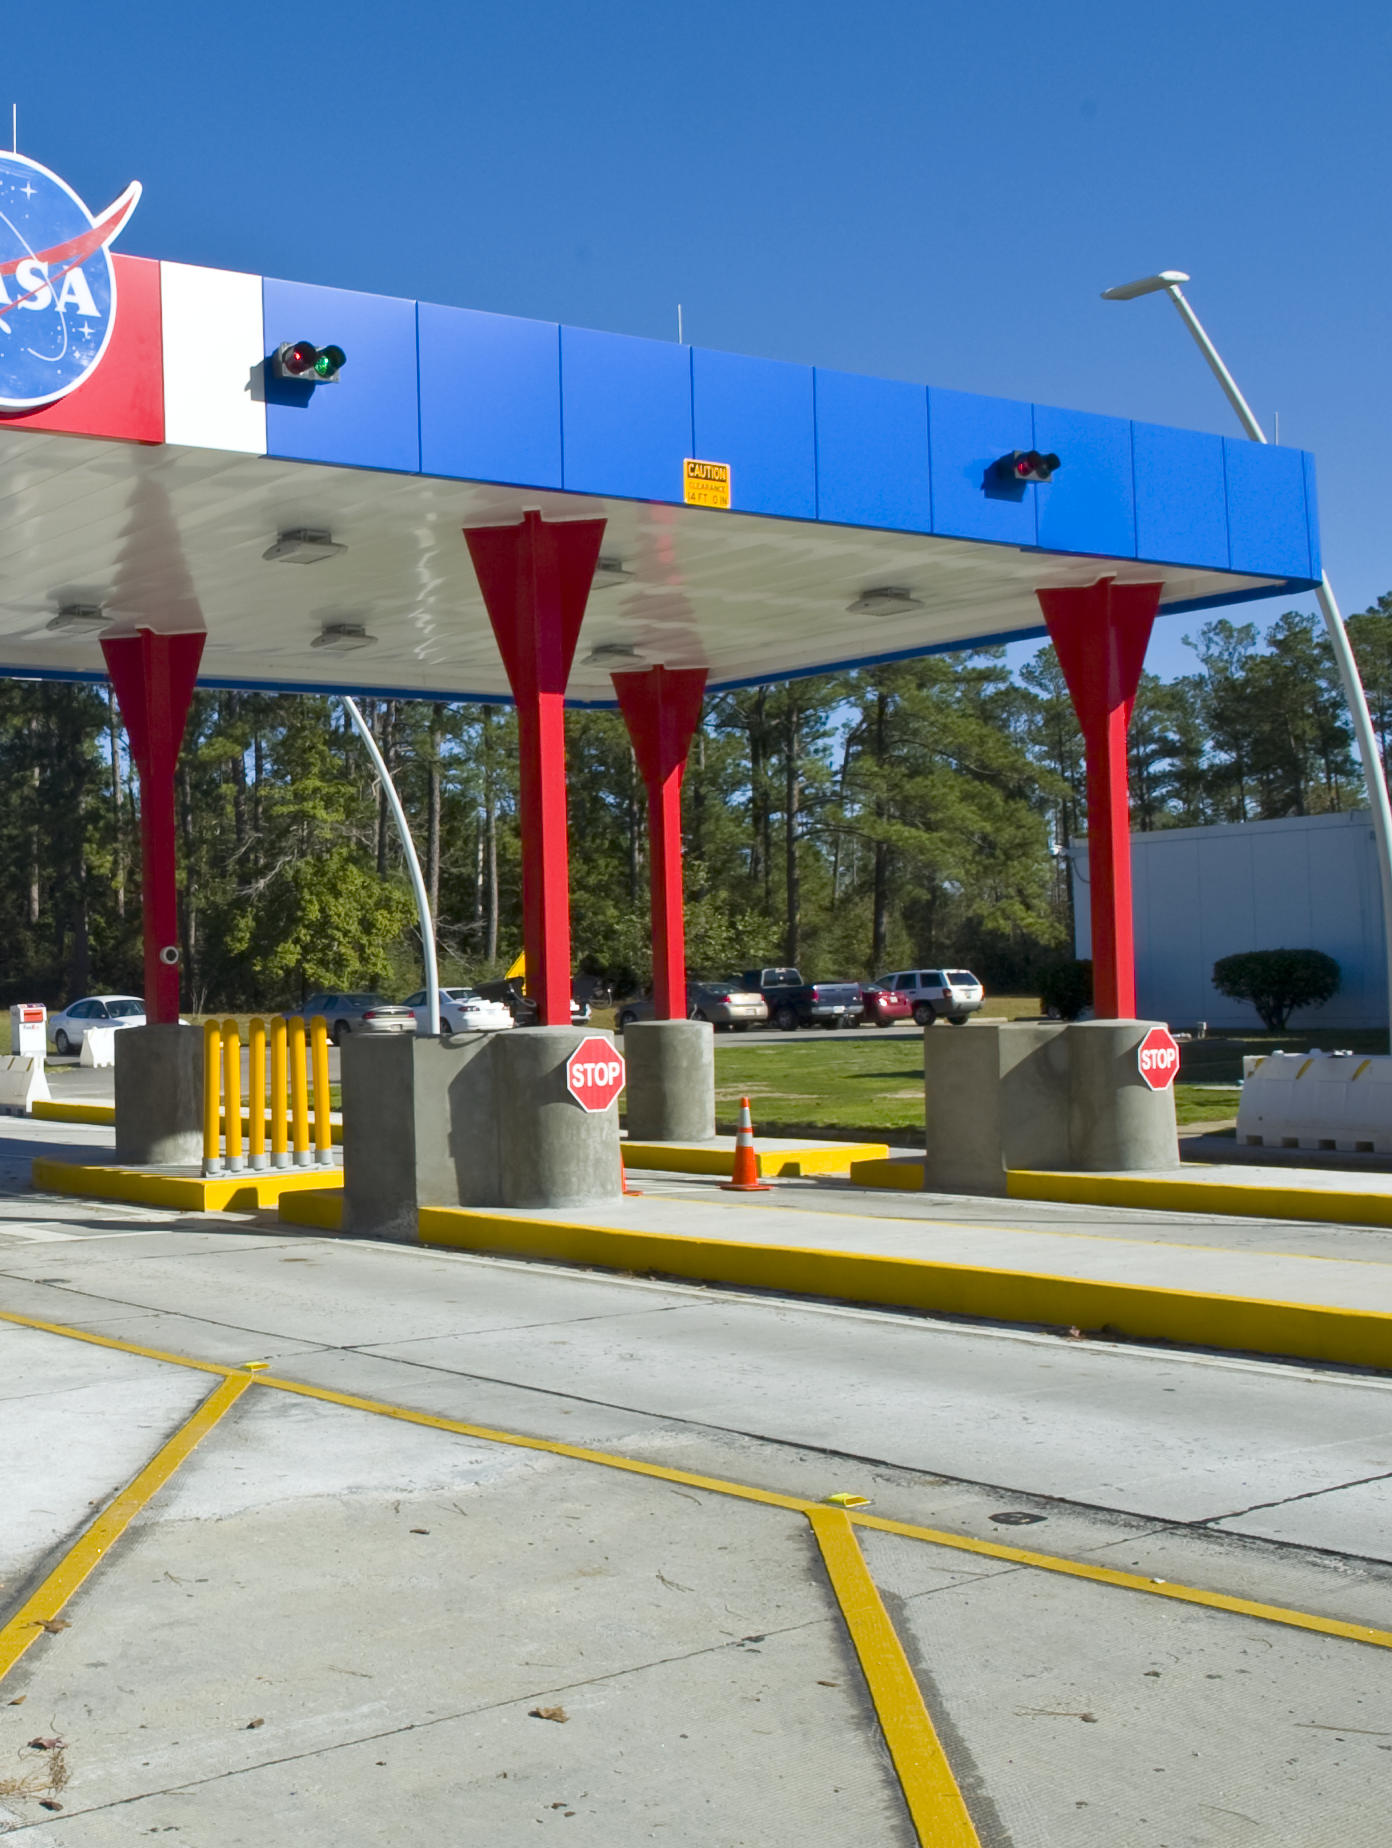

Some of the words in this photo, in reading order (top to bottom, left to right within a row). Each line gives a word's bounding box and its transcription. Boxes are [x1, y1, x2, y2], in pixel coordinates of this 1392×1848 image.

[688, 463, 727, 480] CAUTION
[1142, 1048, 1176, 1070] STOP
[572, 1062, 620, 1088] STOP
